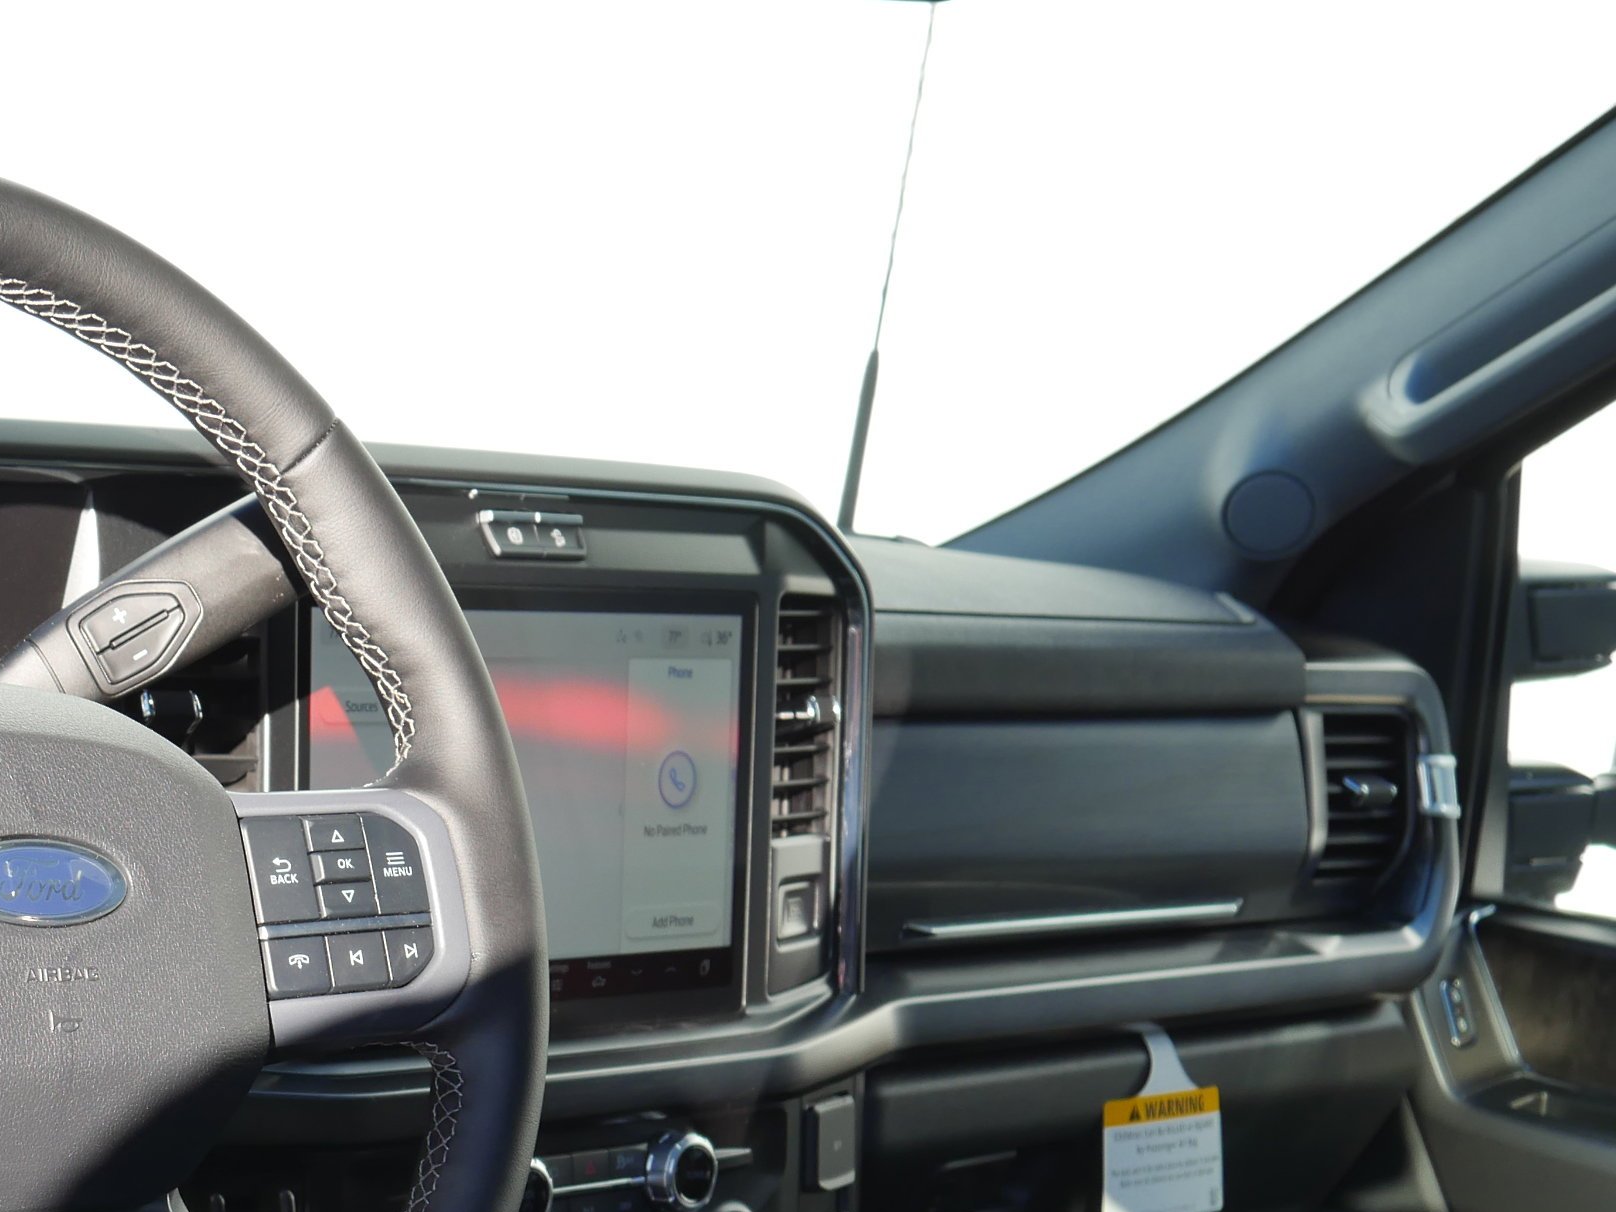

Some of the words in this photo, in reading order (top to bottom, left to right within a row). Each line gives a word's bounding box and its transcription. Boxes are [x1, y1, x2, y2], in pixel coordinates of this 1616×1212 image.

[337, 858, 354, 869] OK
[383, 865, 413, 878] MENU
[270, 873, 299, 885] BACK
[26, 967, 100, 982] AIRBAG
[1145, 1094, 1205, 1121] WARNING
